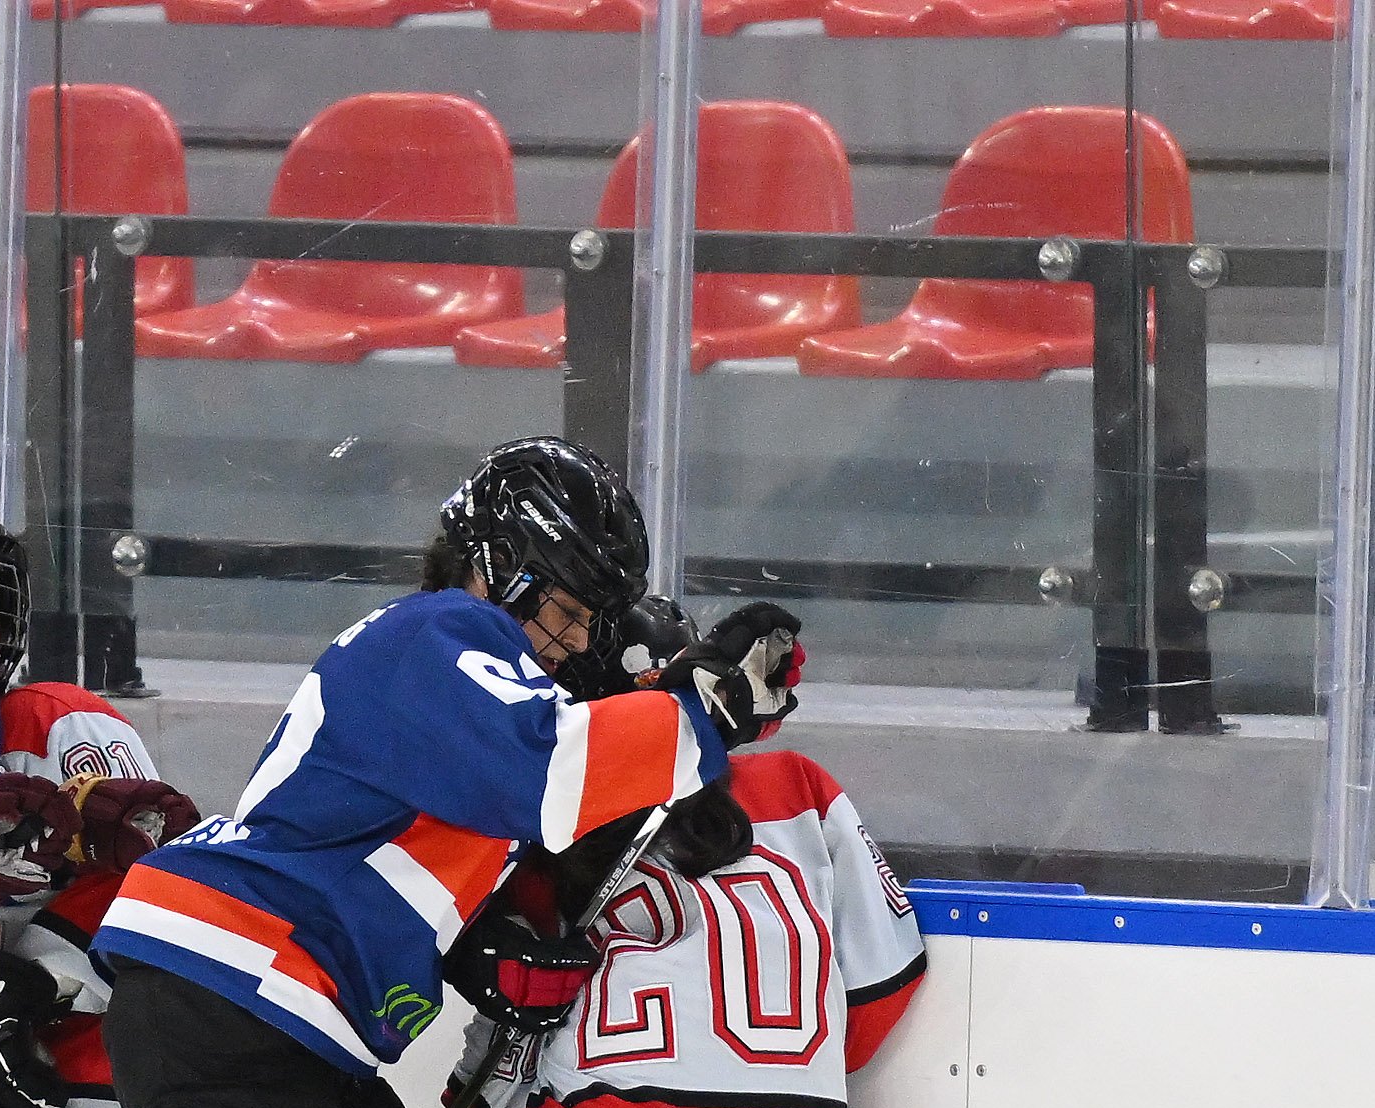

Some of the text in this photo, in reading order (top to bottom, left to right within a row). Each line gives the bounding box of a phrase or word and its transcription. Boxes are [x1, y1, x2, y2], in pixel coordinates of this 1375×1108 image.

[482, 541, 494, 585] BAUER
[598, 878, 616, 900] FLEX
[577, 844, 831, 1072] 20
